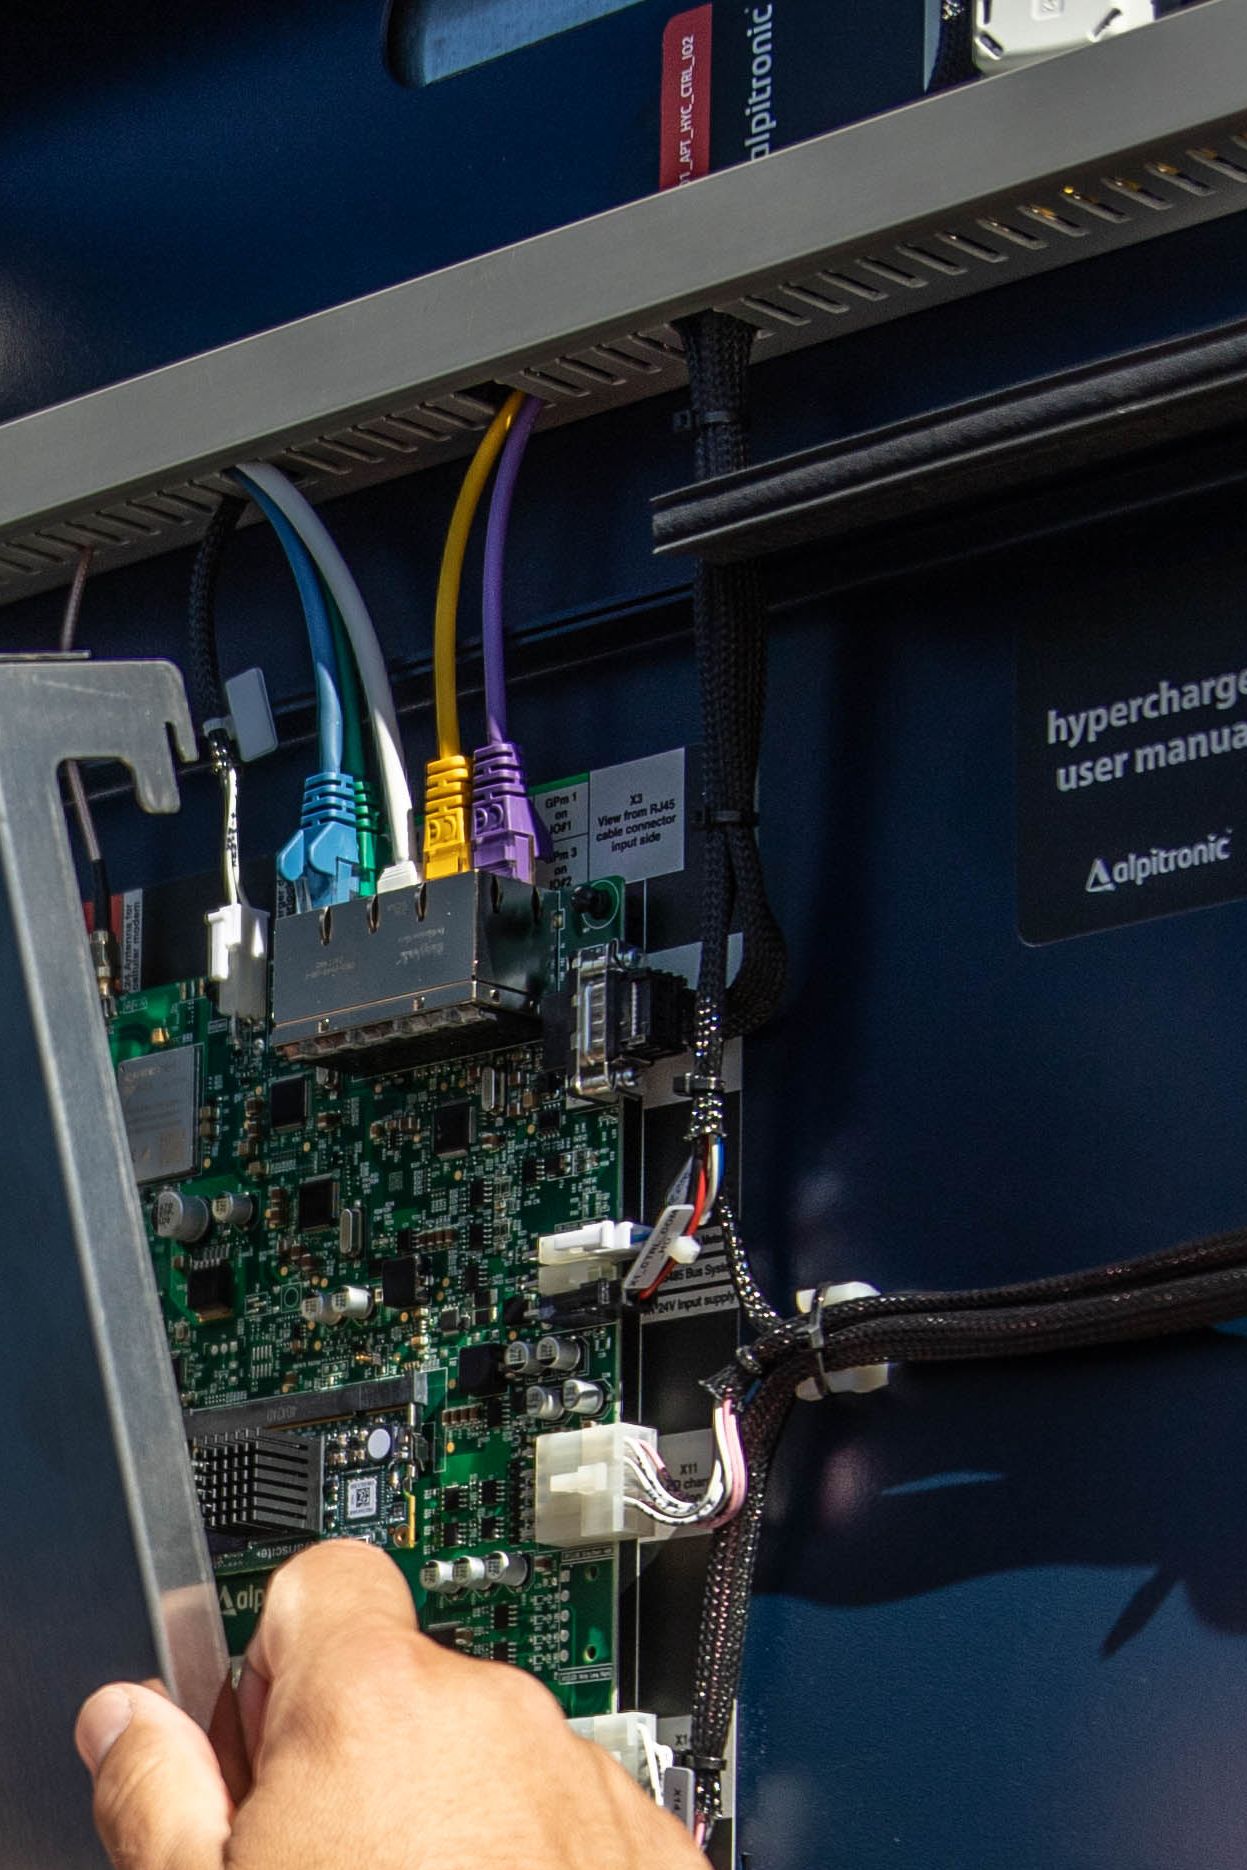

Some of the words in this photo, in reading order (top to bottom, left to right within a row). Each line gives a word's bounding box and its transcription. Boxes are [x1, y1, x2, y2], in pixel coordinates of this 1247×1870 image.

[744, 3, 777, 162] alpitronic
[1056, 751, 1130, 792] user
[545, 794, 569, 810] GPm
[571, 791, 578, 802] 1
[630, 792, 643, 806] X3
[554, 809, 568, 820] on
[597, 813, 622, 827] View
[624, 807, 648, 821] from
[650, 798, 676, 815] RJ45
[596, 827, 623, 842] cable
[625, 814, 677, 834] connector
[611, 836, 637, 853] input
[640, 832, 662, 846] side
[569, 847, 578, 859] 3
[1112, 833, 1232, 886] alpitronic
[554, 865, 568, 875] on
[125, 903, 133, 920] for
[133, 901, 141, 945] modem
[124, 922, 133, 970] Antenna
[686, 1266, 704, 1279] Bus
[703, 1290, 736, 1307] supply
[680, 1462, 698, 1476] X11
[236, 1584, 266, 1614] alp
